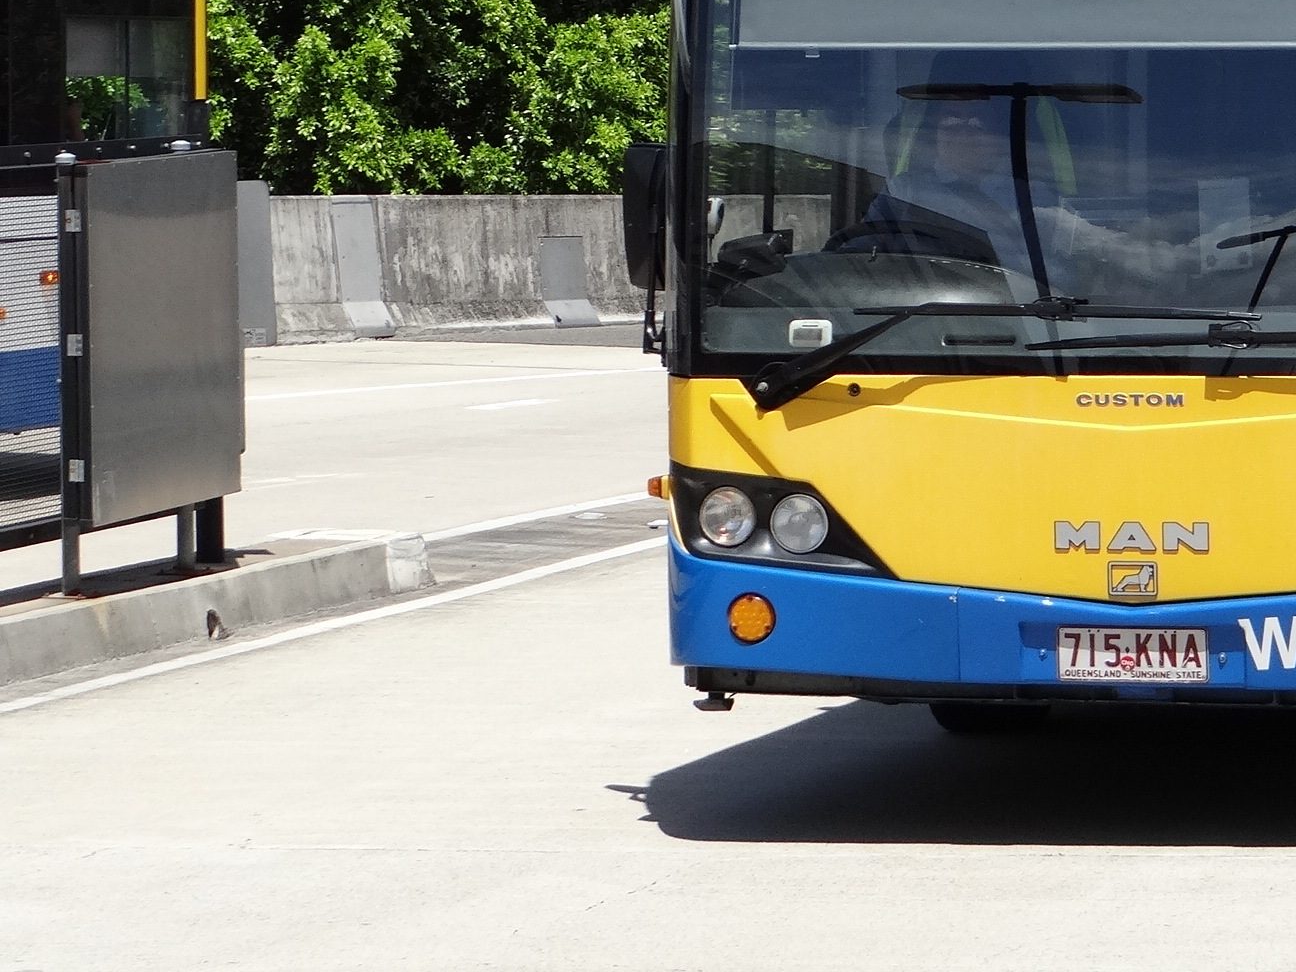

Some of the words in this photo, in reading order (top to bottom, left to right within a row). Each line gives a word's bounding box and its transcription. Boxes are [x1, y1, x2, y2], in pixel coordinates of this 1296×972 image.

[1076, 393, 1185, 407] CUSTOM
[1054, 521, 1210, 554] MAN
[1064, 669, 1122, 678] QUEENSLAND
[1130, 669, 1171, 679] SUNSHINE
[1176, 671, 1202, 679] STATE
